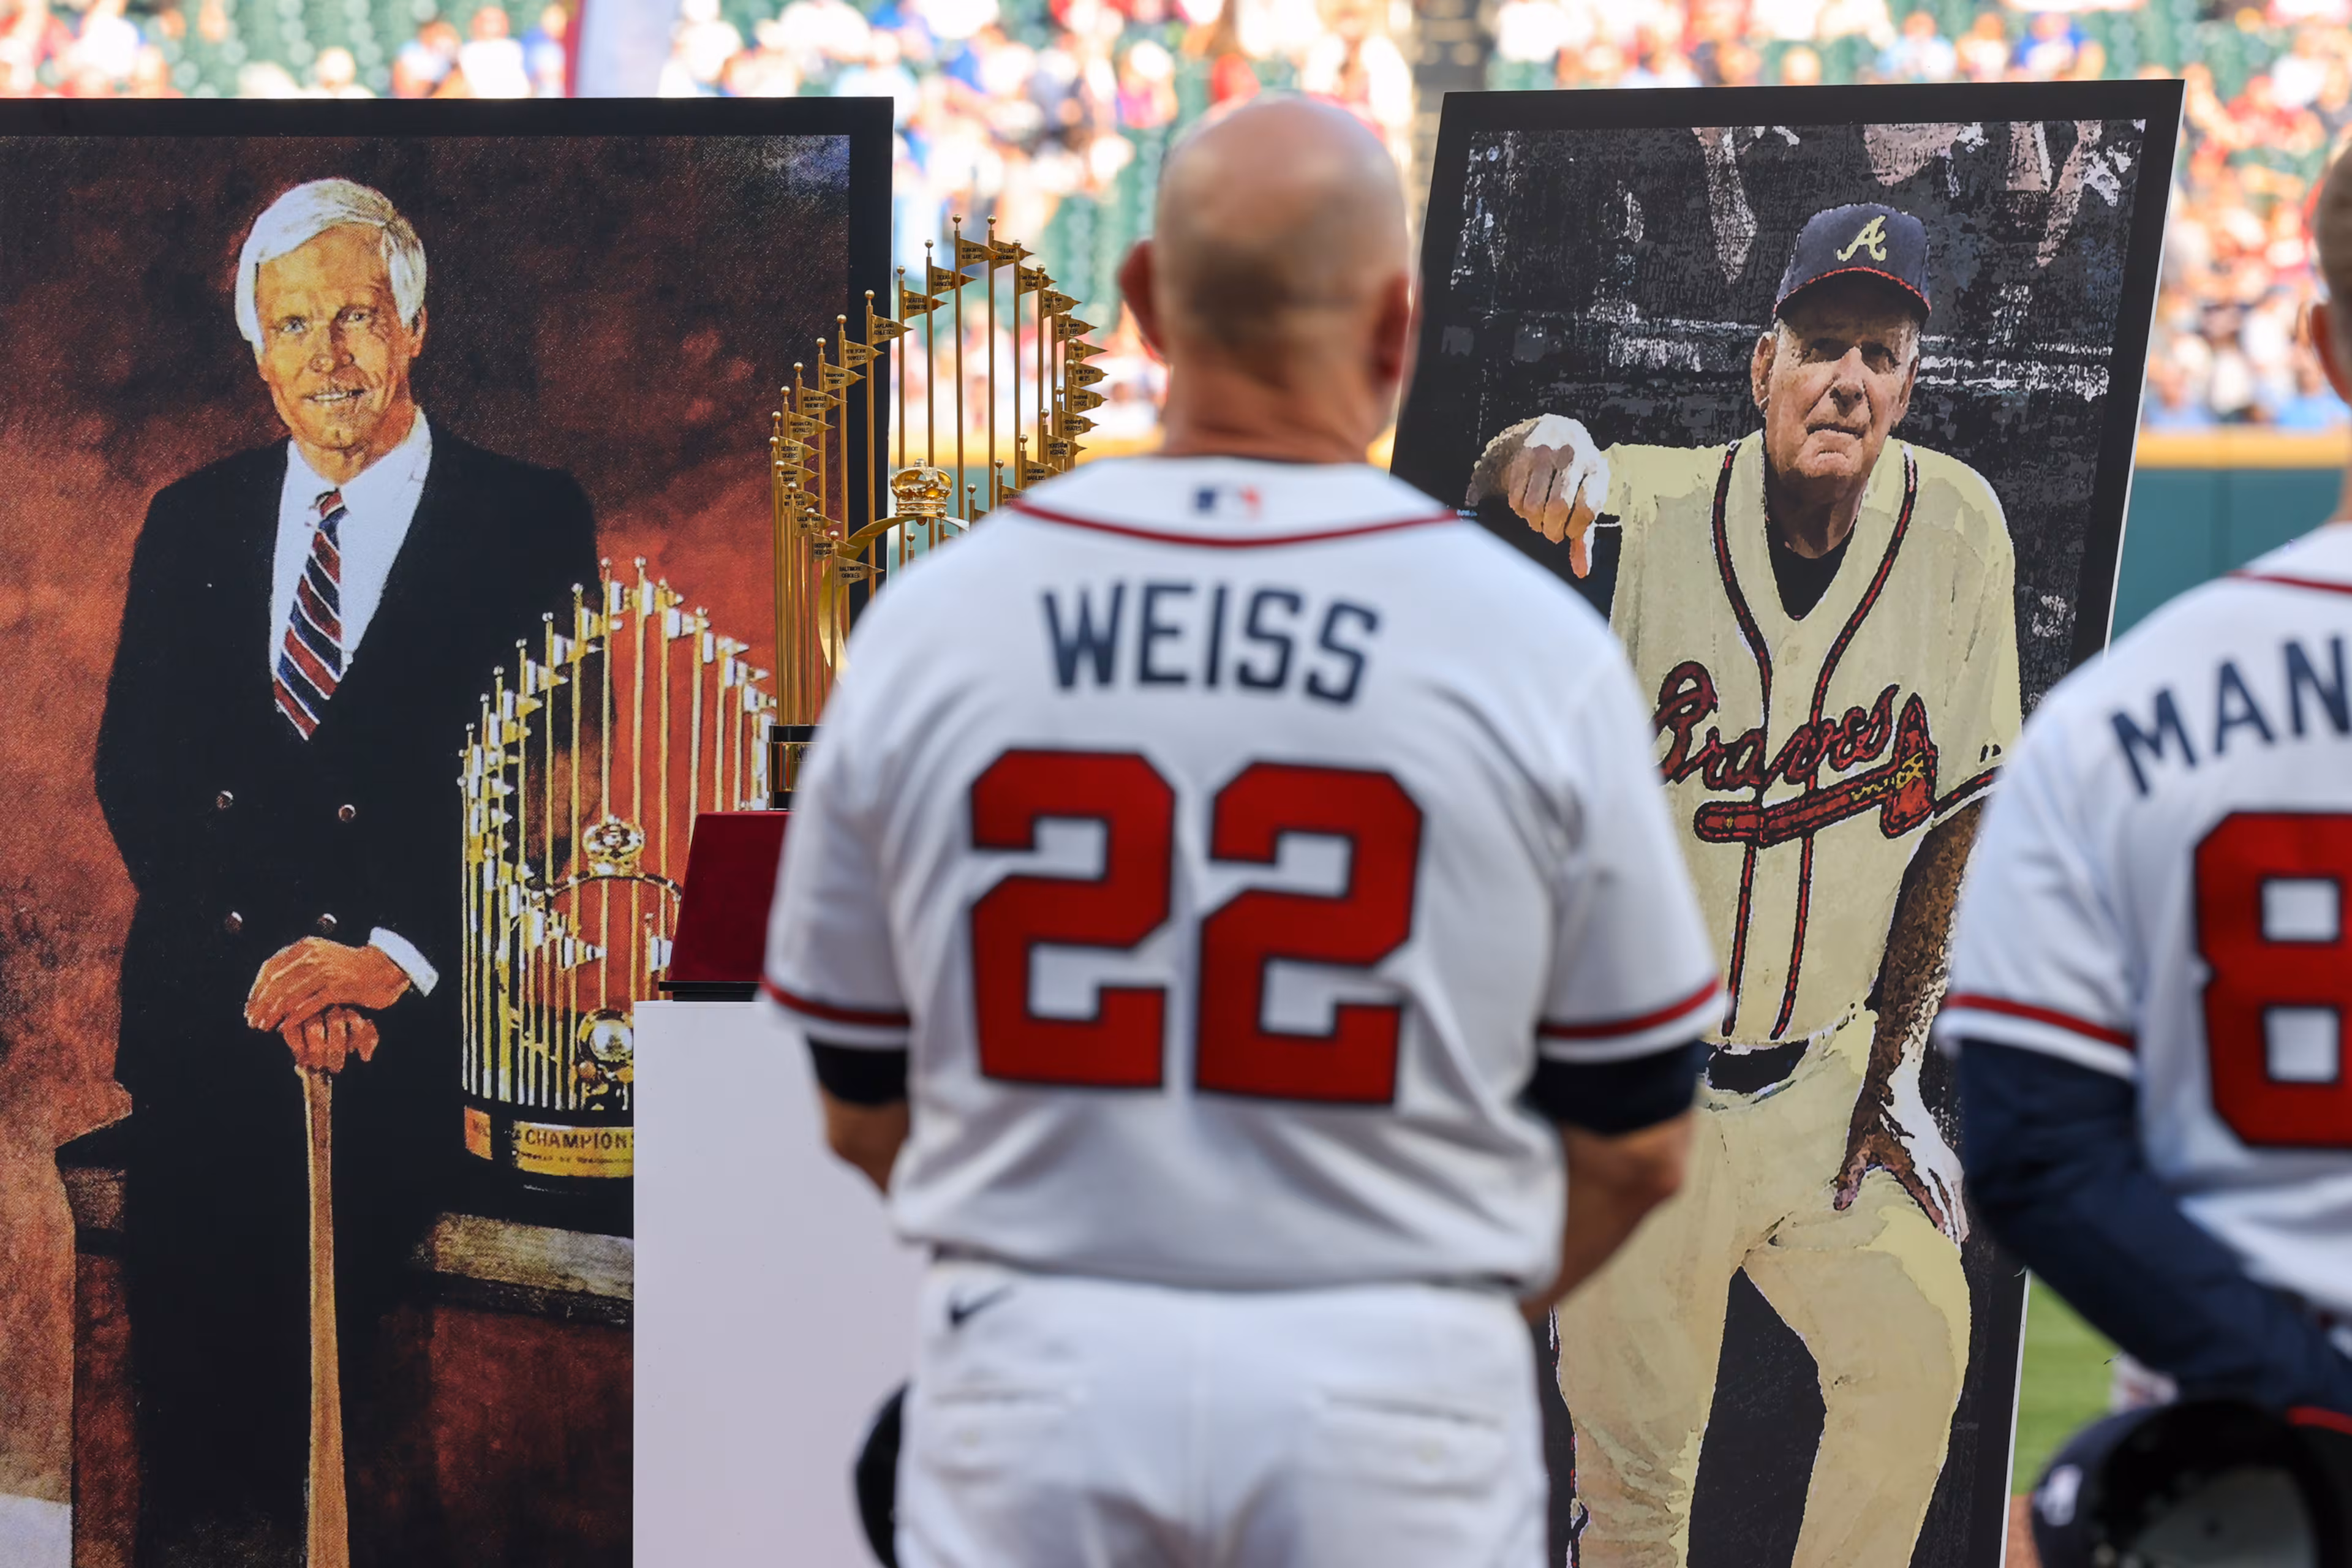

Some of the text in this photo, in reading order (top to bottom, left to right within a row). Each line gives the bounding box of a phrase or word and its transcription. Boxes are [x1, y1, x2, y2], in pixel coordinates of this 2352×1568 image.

[1836, 214, 1887, 262] A
[1042, 581, 1381, 705] WEISS
[1649, 660, 1900, 791] Braves
[970, 748, 1424, 1106] 22
[524, 1128, 633, 1150] CHAMPION
